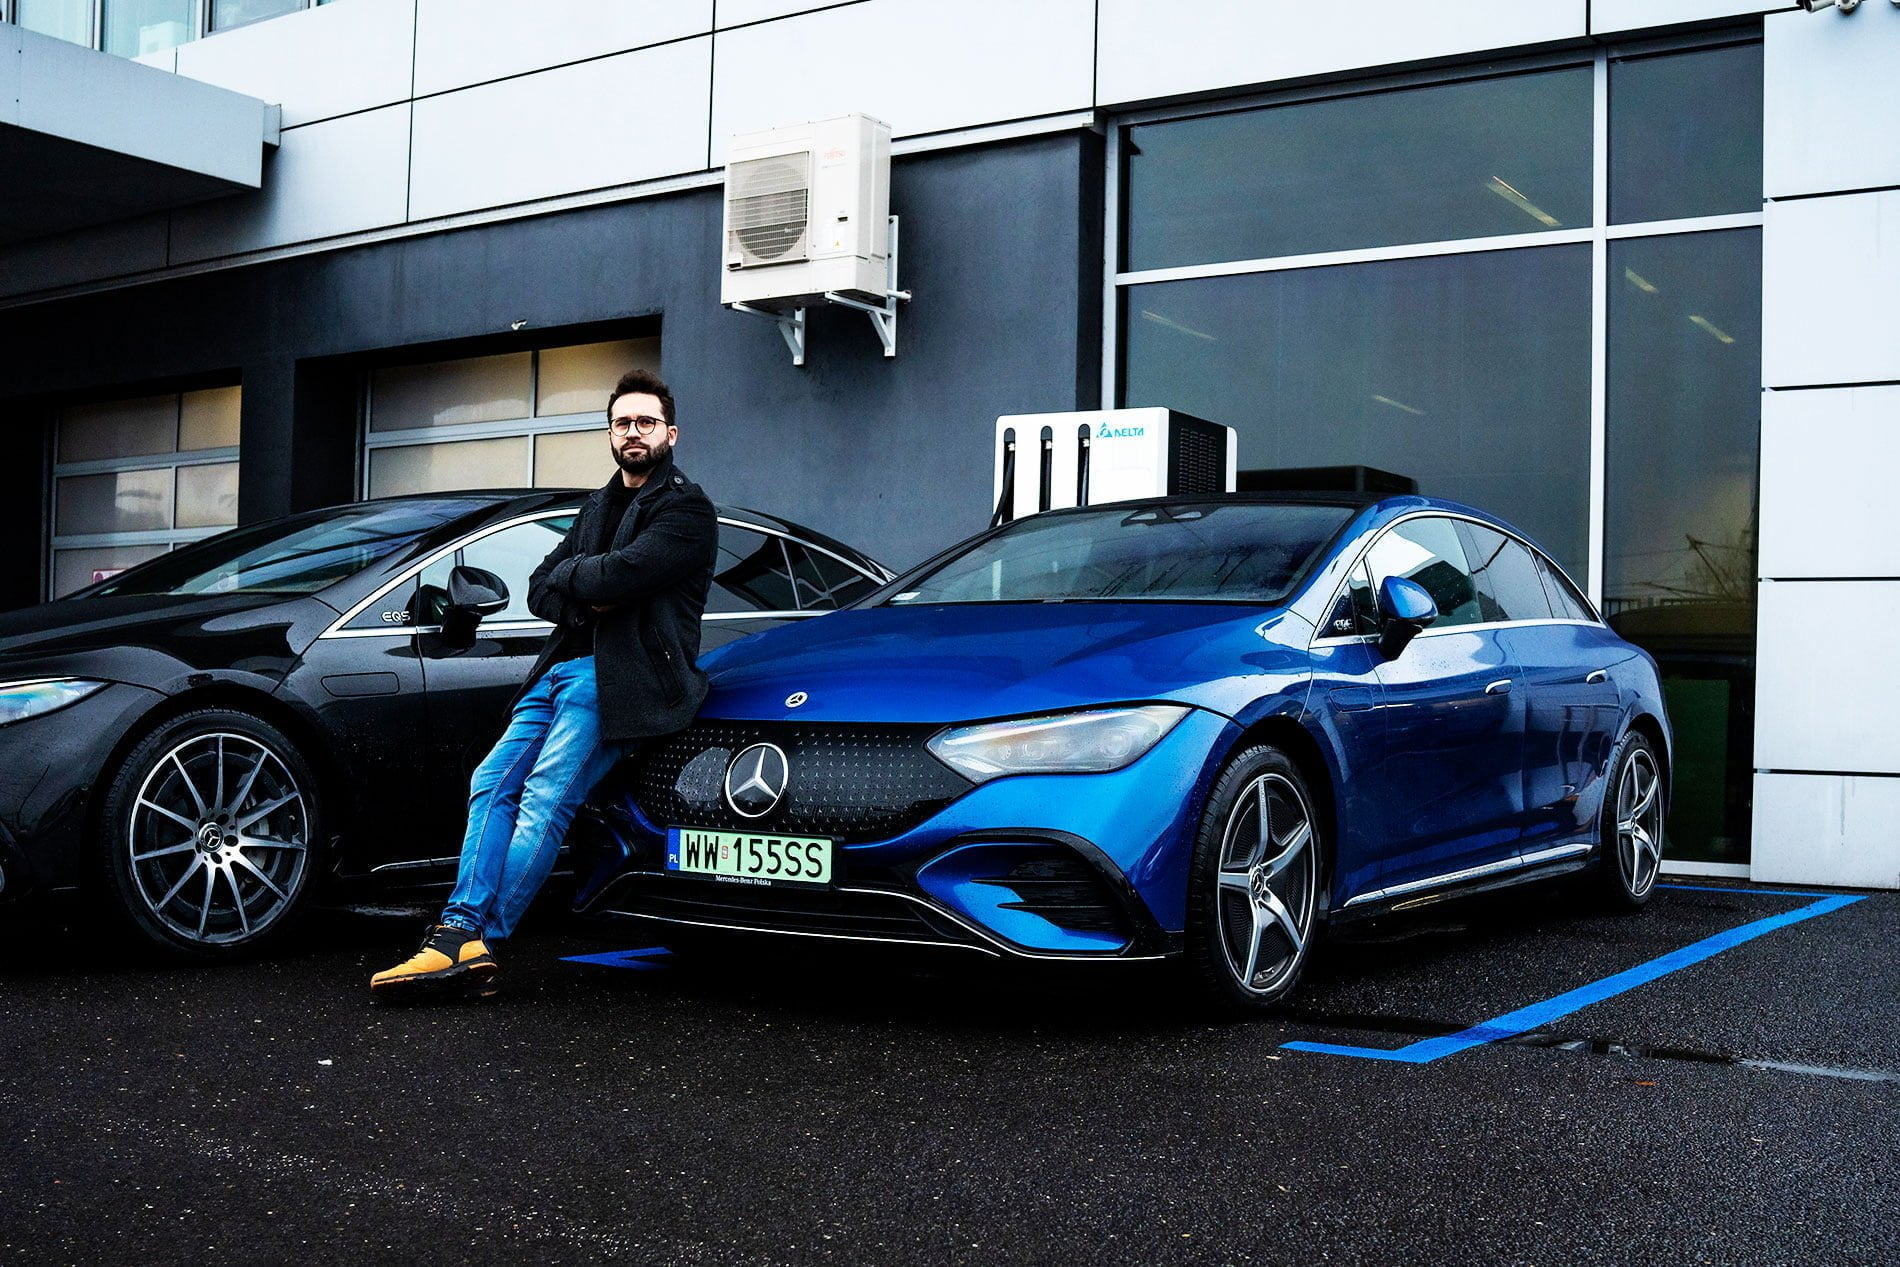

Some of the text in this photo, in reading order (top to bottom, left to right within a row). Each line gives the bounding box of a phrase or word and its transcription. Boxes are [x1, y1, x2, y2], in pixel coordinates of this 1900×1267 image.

[1114, 427, 1144, 437] DELTA
[381, 610, 411, 622] EQS
[668, 853, 679, 864] PL
[686, 833, 823, 878] WW 155SS
